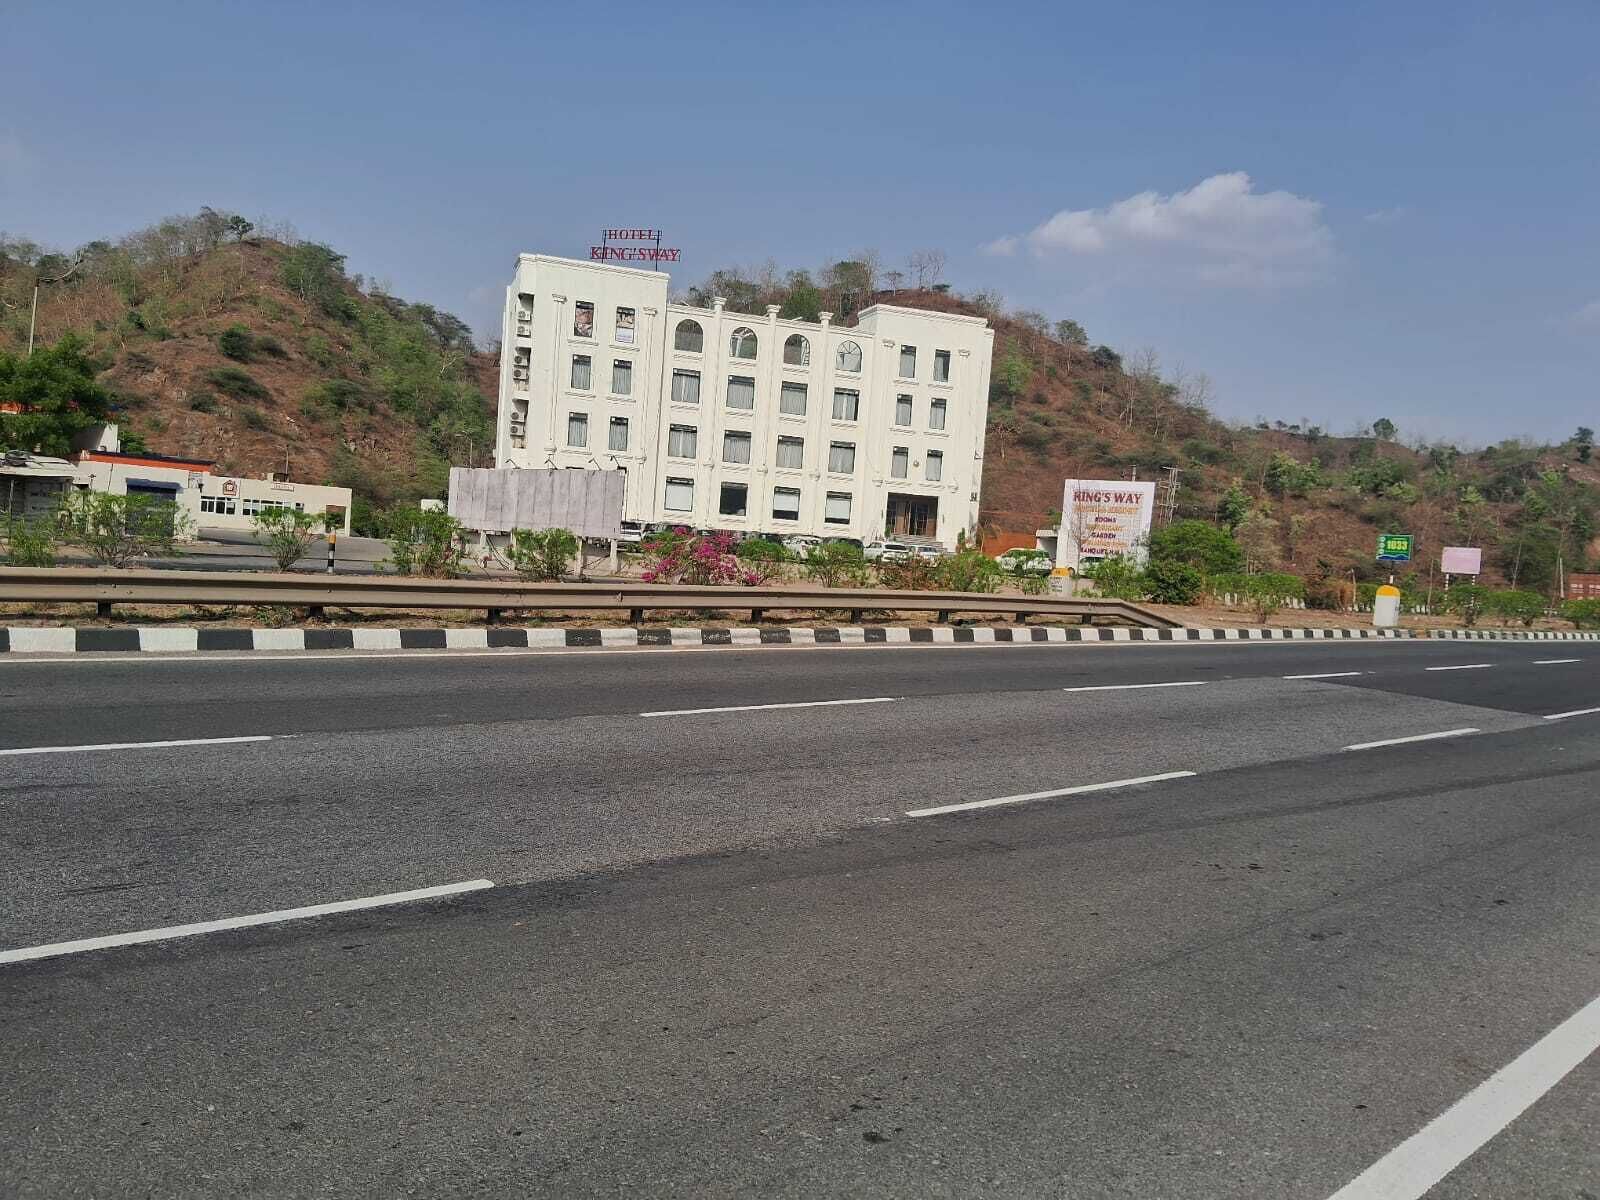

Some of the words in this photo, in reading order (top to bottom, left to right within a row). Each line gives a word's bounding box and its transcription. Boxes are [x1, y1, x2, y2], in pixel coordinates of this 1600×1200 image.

[608, 229, 656, 240] HOTEL
[1073, 491, 1111, 503] KING'S
[1113, 492, 1144, 504] WAY
[1387, 540, 1408, 550] 1033
